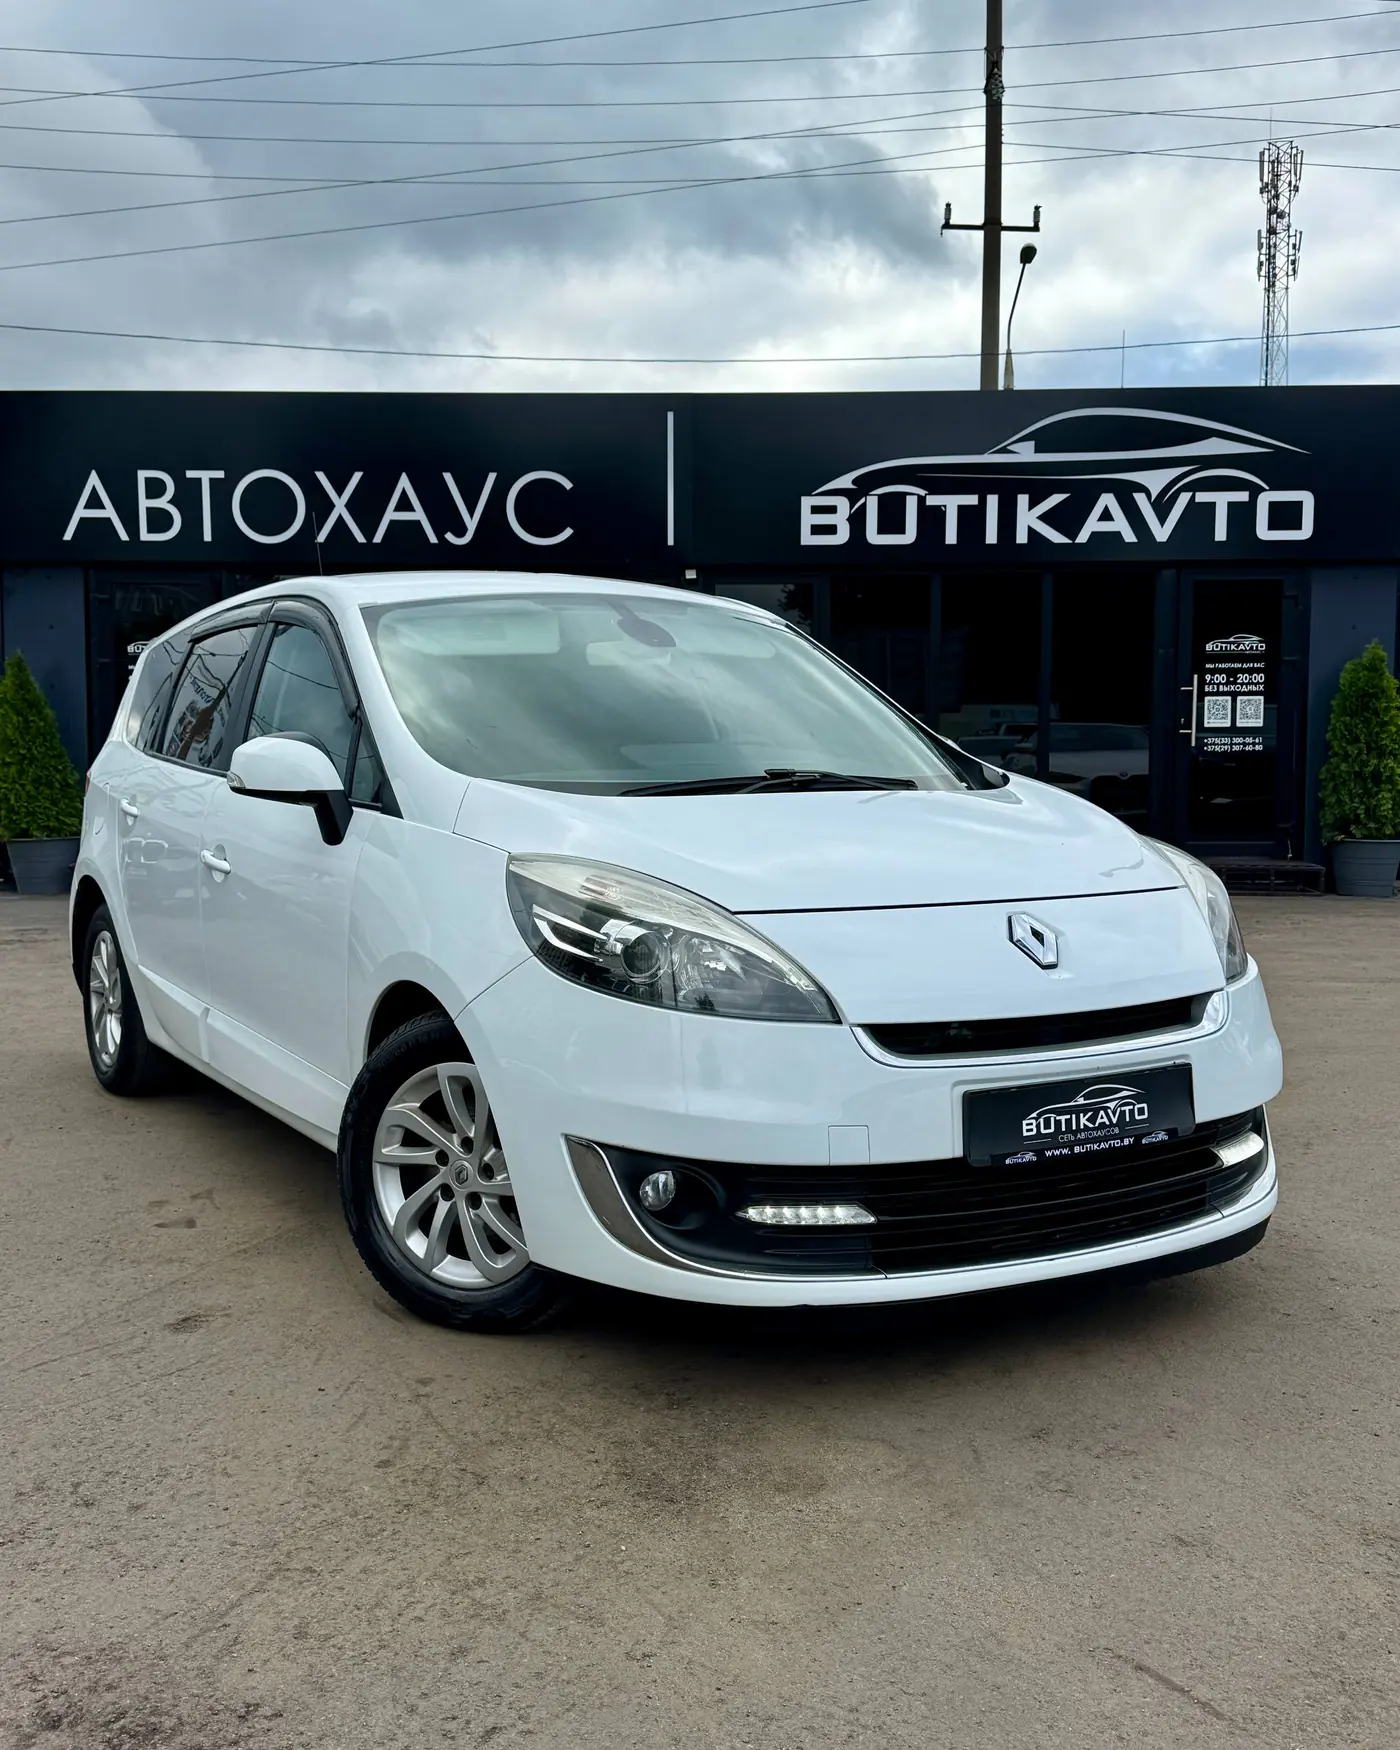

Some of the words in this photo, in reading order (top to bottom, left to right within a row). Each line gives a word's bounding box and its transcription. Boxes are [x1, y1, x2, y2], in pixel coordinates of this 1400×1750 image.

[63, 468, 574, 546] АВТОХАУС
[800, 490, 1315, 546] BUTIKAVTO
[1205, 643, 1266, 651] BUTIKAVTO
[1205, 674, 1227, 683] 9:00
[1236, 673, 1265, 683] 20:00
[1204, 684, 1217, 692] БЕЗ
[1219, 684, 1265, 692] ВЫХОДНЫХ
[1204, 745, 1231, 753] +375(29)
[1022, 1103, 1149, 1137] BUTIKAVTO
[1058, 1133, 1075, 1142] СЕТЬ
[1076, 1127, 1120, 1141] АВТОХАУСОВ
[1045, 1148, 1072, 1157] WWW.
[1074, 1138, 1134, 1152] BUTIKAVTO.BY
[1005, 1156, 1037, 1165] BUTIKAVTO
